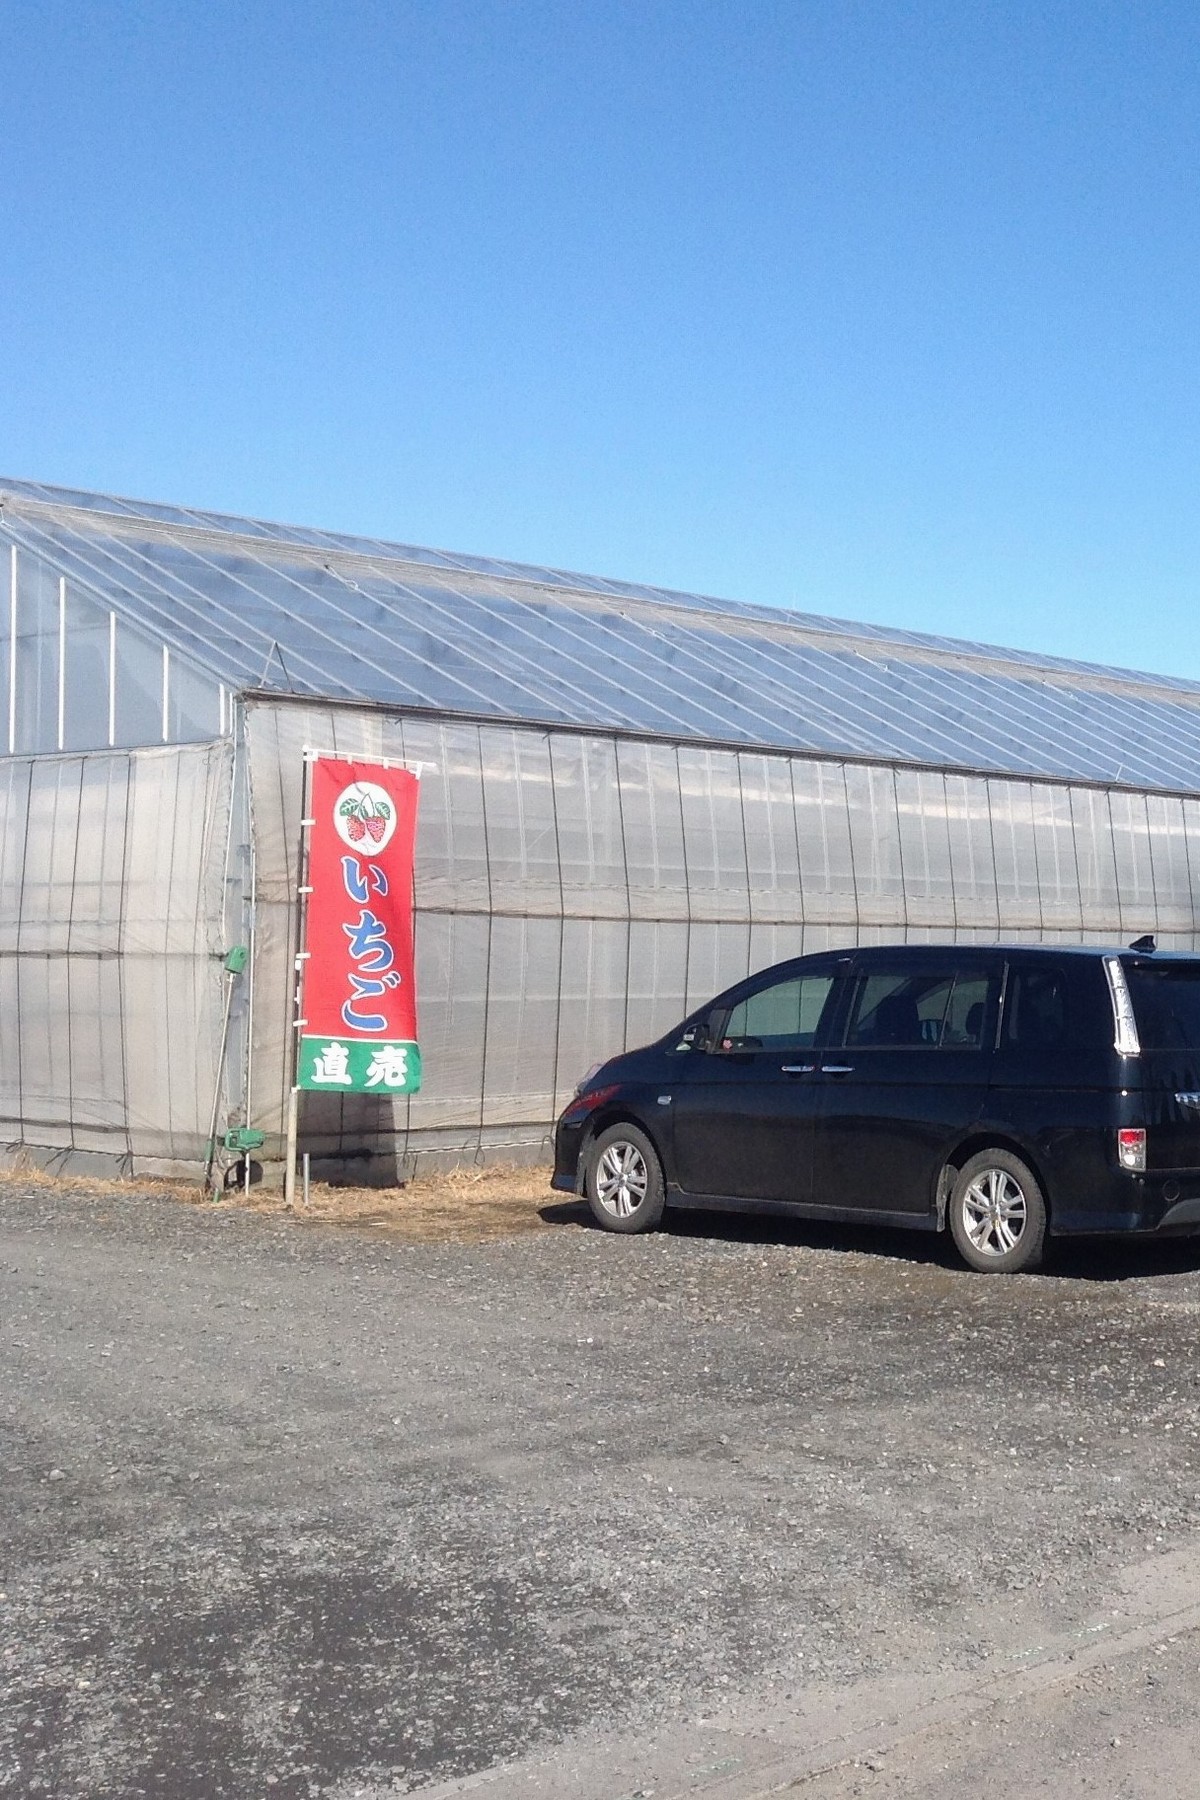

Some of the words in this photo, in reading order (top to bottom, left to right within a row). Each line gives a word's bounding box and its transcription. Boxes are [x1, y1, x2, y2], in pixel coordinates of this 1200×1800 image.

[341, 857, 401, 1031] いちご
[312, 1042, 408, 1086] 直売
